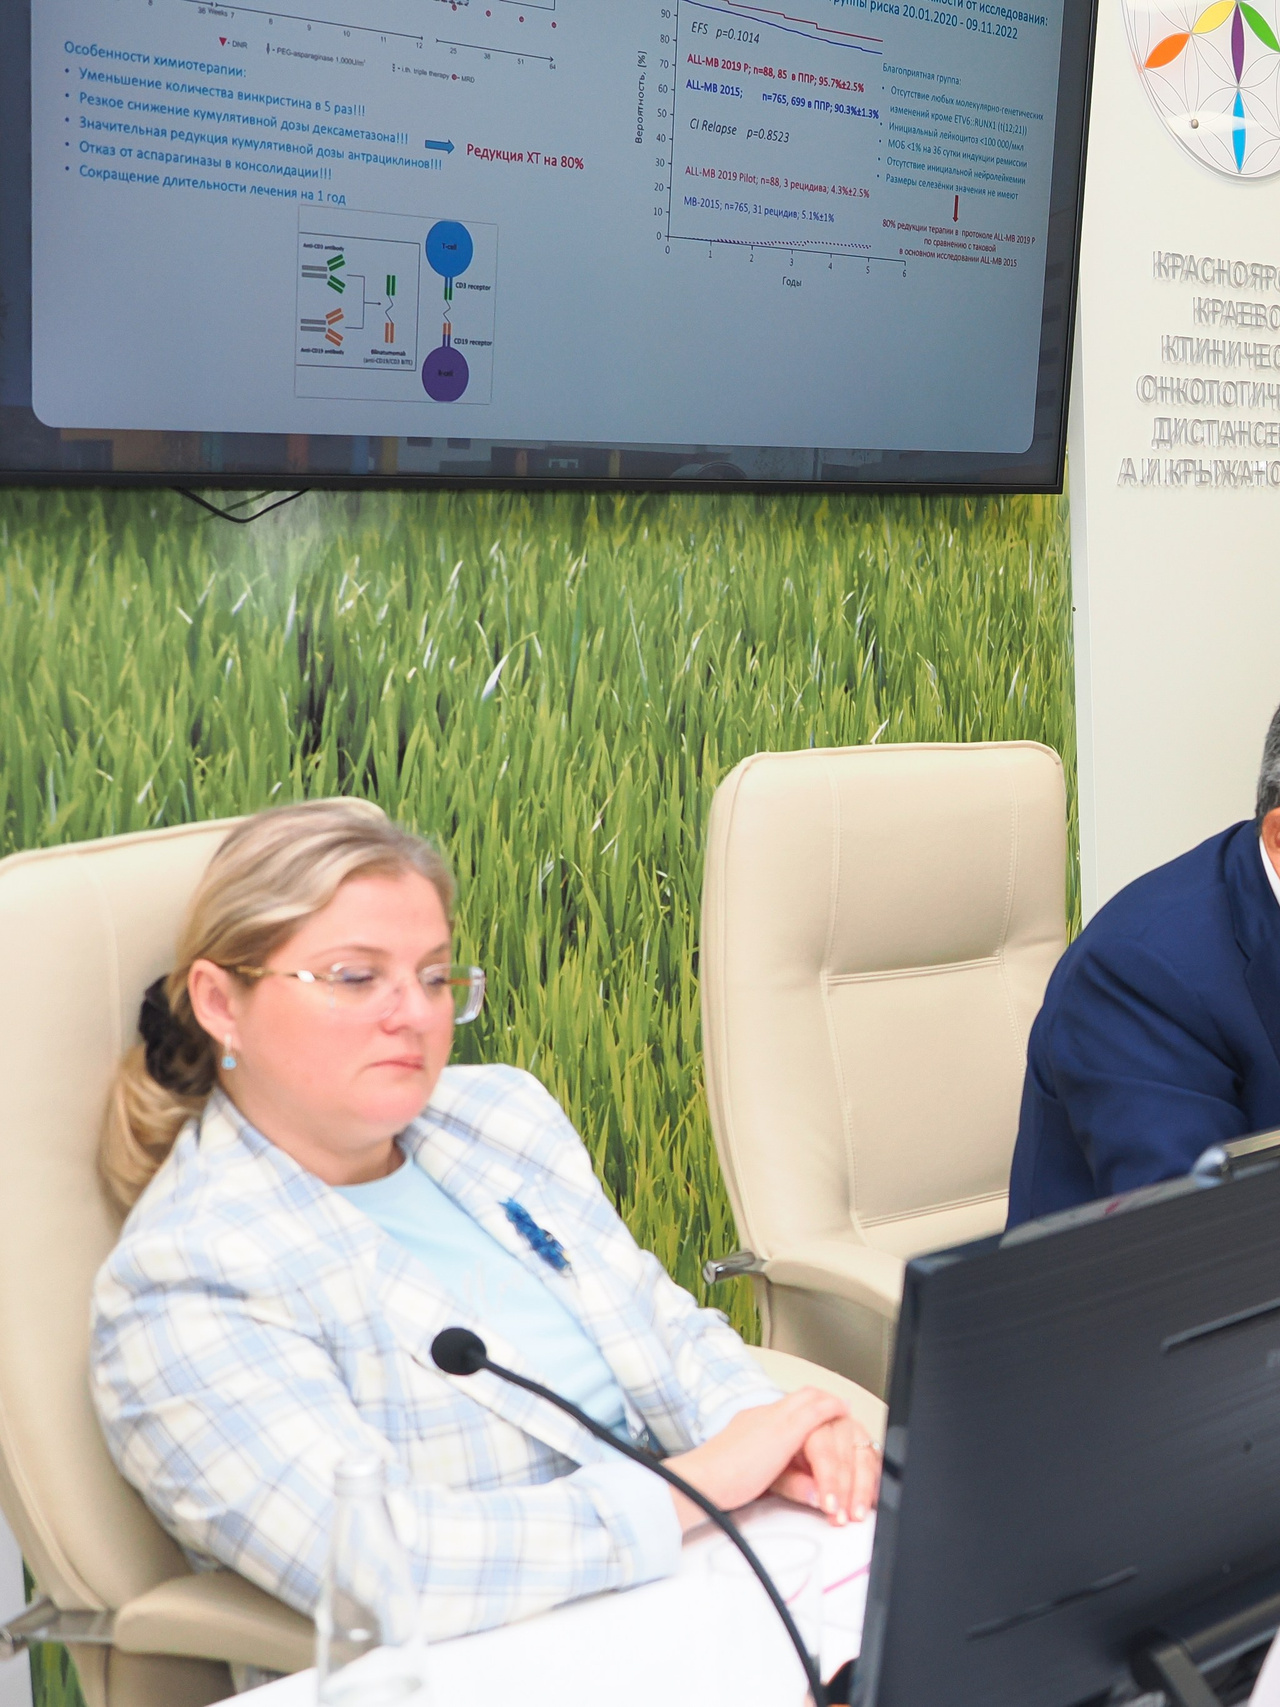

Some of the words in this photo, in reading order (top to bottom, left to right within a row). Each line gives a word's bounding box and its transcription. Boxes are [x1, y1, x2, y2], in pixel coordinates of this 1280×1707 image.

[661, 10, 671, 19] 90
[870, 1, 900, 15] риска
[903, 4, 957, 27] 20.01.2020
[966, 18, 1018, 40] 09.11.2022
[966, 2, 977, 10] от
[980, 4, 1048, 26] исследования:
[660, 35, 669, 44] 80
[691, 21, 708, 35] EFS
[716, 28, 760, 44] p=0.1014
[64, 41, 150, 64] Особенности
[153, 57, 247, 77] химиотерапии:
[659, 60, 669, 69] 70
[687, 53, 719, 68] ALL-MB
[721, 60, 741, 72] 2019
[753, 67, 776, 79] n=88,
[778, 69, 787, 80] 85
[798, 72, 817, 86] ППР;
[883, 63, 935, 80] Благоприятная
[937, 74, 962, 85] группа:
[79, 67, 162, 89] Уменьшение
[166, 82, 234, 99] количества
[238, 90, 311, 110] винкристина
[315, 102, 321, 111] в
[325, 100, 330, 112] 5
[334, 104, 365, 116] раз!!!
[658, 84, 668, 94] 60
[686, 78, 718, 93] ALL-MB
[720, 84, 743, 98] 2015;
[762, 93, 789, 107] n=765,
[791, 96, 805, 107] 699
[814, 100, 833, 113] ППР;
[634, 72, 647, 144] Вероятность,
[657, 109, 667, 118] 50
[891, 85, 930, 101] Отсутствие
[931, 94, 954, 105] любых
[956, 98, 1043, 121] молекулярно-генетических
[80, 92, 124, 108] Резкое
[127, 100, 190, 117] снижение
[193, 109, 277, 128] кумулятивной
[281, 119, 309, 132] дозы
[313, 124, 408, 144] дексаметазона!!!
[890, 105, 929, 119] изменений
[931, 112, 952, 123] кроме
[954, 116, 996, 130] ETV6::RUNX1
[80, 116, 167, 138] Значительная
[171, 129, 228, 144] редукция
[231, 136, 314, 155] кумулятивной
[316, 146, 344, 159] дозы
[348, 151, 442, 170] антрациклинов!!!
[656, 134, 666, 143] 40
[702, 121, 737, 136] Relapse
[747, 128, 790, 144] p=0.8523
[889, 122, 938, 137] Инициальный
[939, 130, 978, 145] лейкоцитоз
[80, 141, 116, 156] Отказ
[120, 147, 133, 157] от
[137, 150, 221, 168] аспарагиназы
[226, 160, 231, 168] в
[235, 161, 332, 179] консолидации!!!
[467, 144, 523, 163] Редукция
[527, 152, 541, 164] ХТ
[544, 156, 557, 167] на
[560, 156, 584, 170] 80%
[655, 158, 665, 167] 30
[888, 139, 905, 150] МОБ
[907, 141, 921, 152] <1%
[923, 145, 931, 154] на
[933, 146, 941, 155] 36
[943, 149, 961, 160] сутки
[962, 152, 994, 163] индукции
[996, 157, 1027, 168] ремиссии
[685, 166, 716, 178] ALL-MB
[718, 170, 737, 182] 2019
[739, 173, 758, 185] Pilot;
[760, 176, 782, 188] n=88,
[790, 181, 829, 194] рецидива;
[887, 156, 925, 171] Отсутствие
[927, 164, 972, 177] инициальной
[974, 170, 1025, 185] нейролейкемии
[80, 165, 159, 184] Сокращение
[163, 175, 246, 193] длительности
[250, 184, 297, 198] лечения
[301, 191, 314, 200] на
[318, 190, 323, 201] 1
[327, 193, 346, 205] год
[654, 182, 664, 192] 20
[886, 173, 917, 186] Размеры
[919, 180, 953, 191] селезёнки
[955, 185, 986, 196] значения
[988, 189, 996, 197] не
[997, 191, 1018, 200] имеют
[654, 207, 663, 216] 10
[684, 196, 722, 211] MB-2015;
[725, 201, 751, 214] n=765,
[753, 204, 762, 215] 31
[764, 206, 799, 220] рецидив;
[656, 231, 662, 240] 0
[883, 218, 896, 228] 80%
[897, 222, 927, 234] редукции
[929, 225, 953, 236] терапии
[962, 229, 992, 240] протоколе
[994, 232, 1015, 243] ALL-MB
[1017, 235, 1030, 244] 2019
[665, 245, 670, 254] 0
[905, 248, 935, 259] основном
[937, 250, 979, 263] исследовании
[981, 256, 1002, 266] ALL-MB
[1003, 258, 1017, 267] 2015
[924, 238, 932, 246] по
[933, 239, 967, 250] сравнению
[973, 242, 996, 253] таковой
[782, 276, 802, 288] Годы
